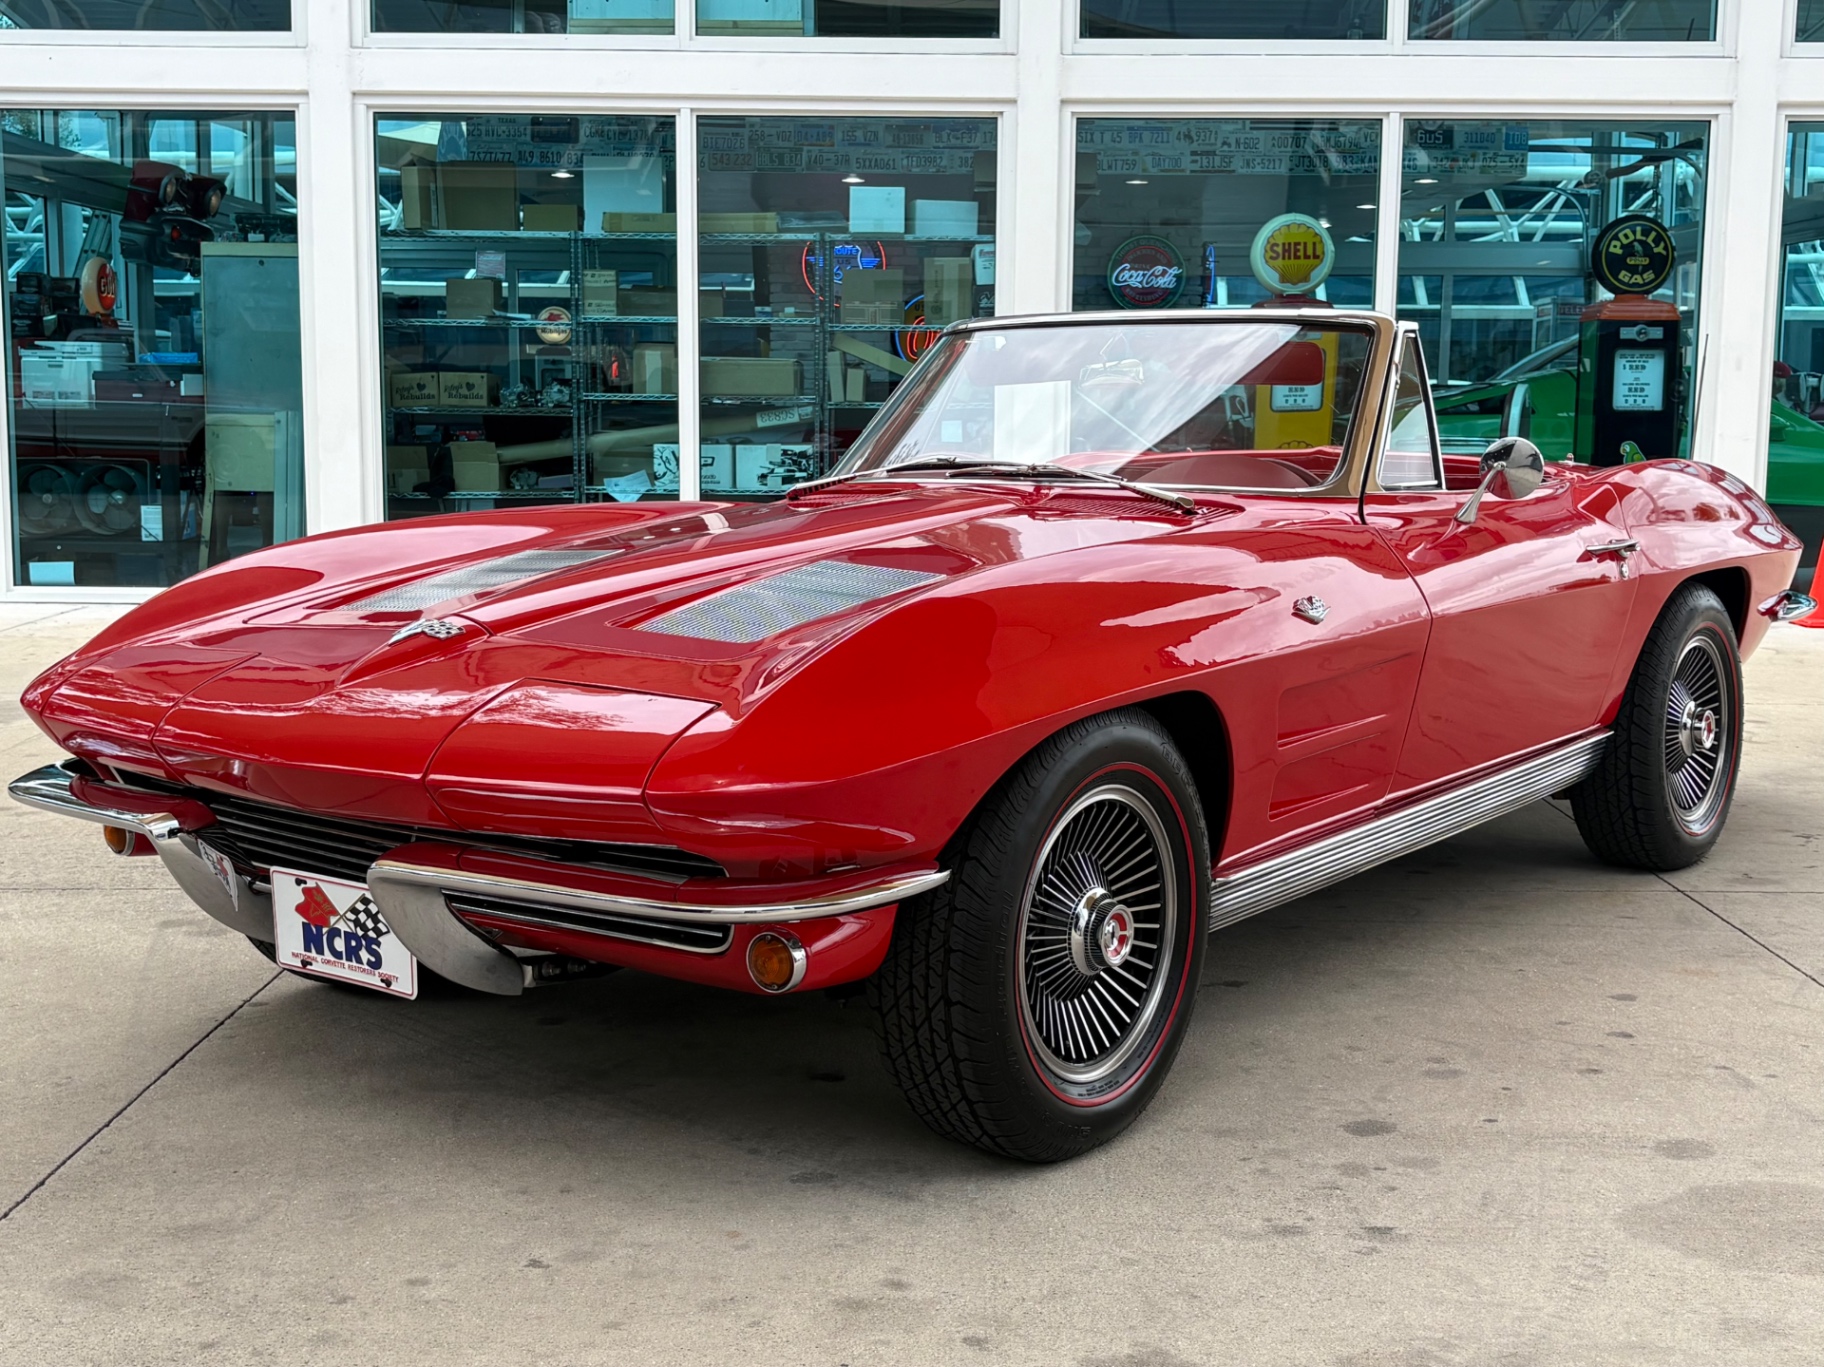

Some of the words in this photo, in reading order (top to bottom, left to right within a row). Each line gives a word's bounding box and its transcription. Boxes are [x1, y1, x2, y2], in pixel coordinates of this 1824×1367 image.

[1269, 241, 1320, 261] SHELL
[1608, 226, 1667, 256] POLLY
[1112, 263, 1183, 289] Coca-Cola
[1618, 270, 1656, 284] GAS
[302, 921, 383, 971] NCRS
[291, 951, 318, 963] NATIONAL
[321, 957, 346, 969] CORVETTE
[348, 963, 376, 976] RESTORERS
[377, 971, 399, 982] SOCIETY
